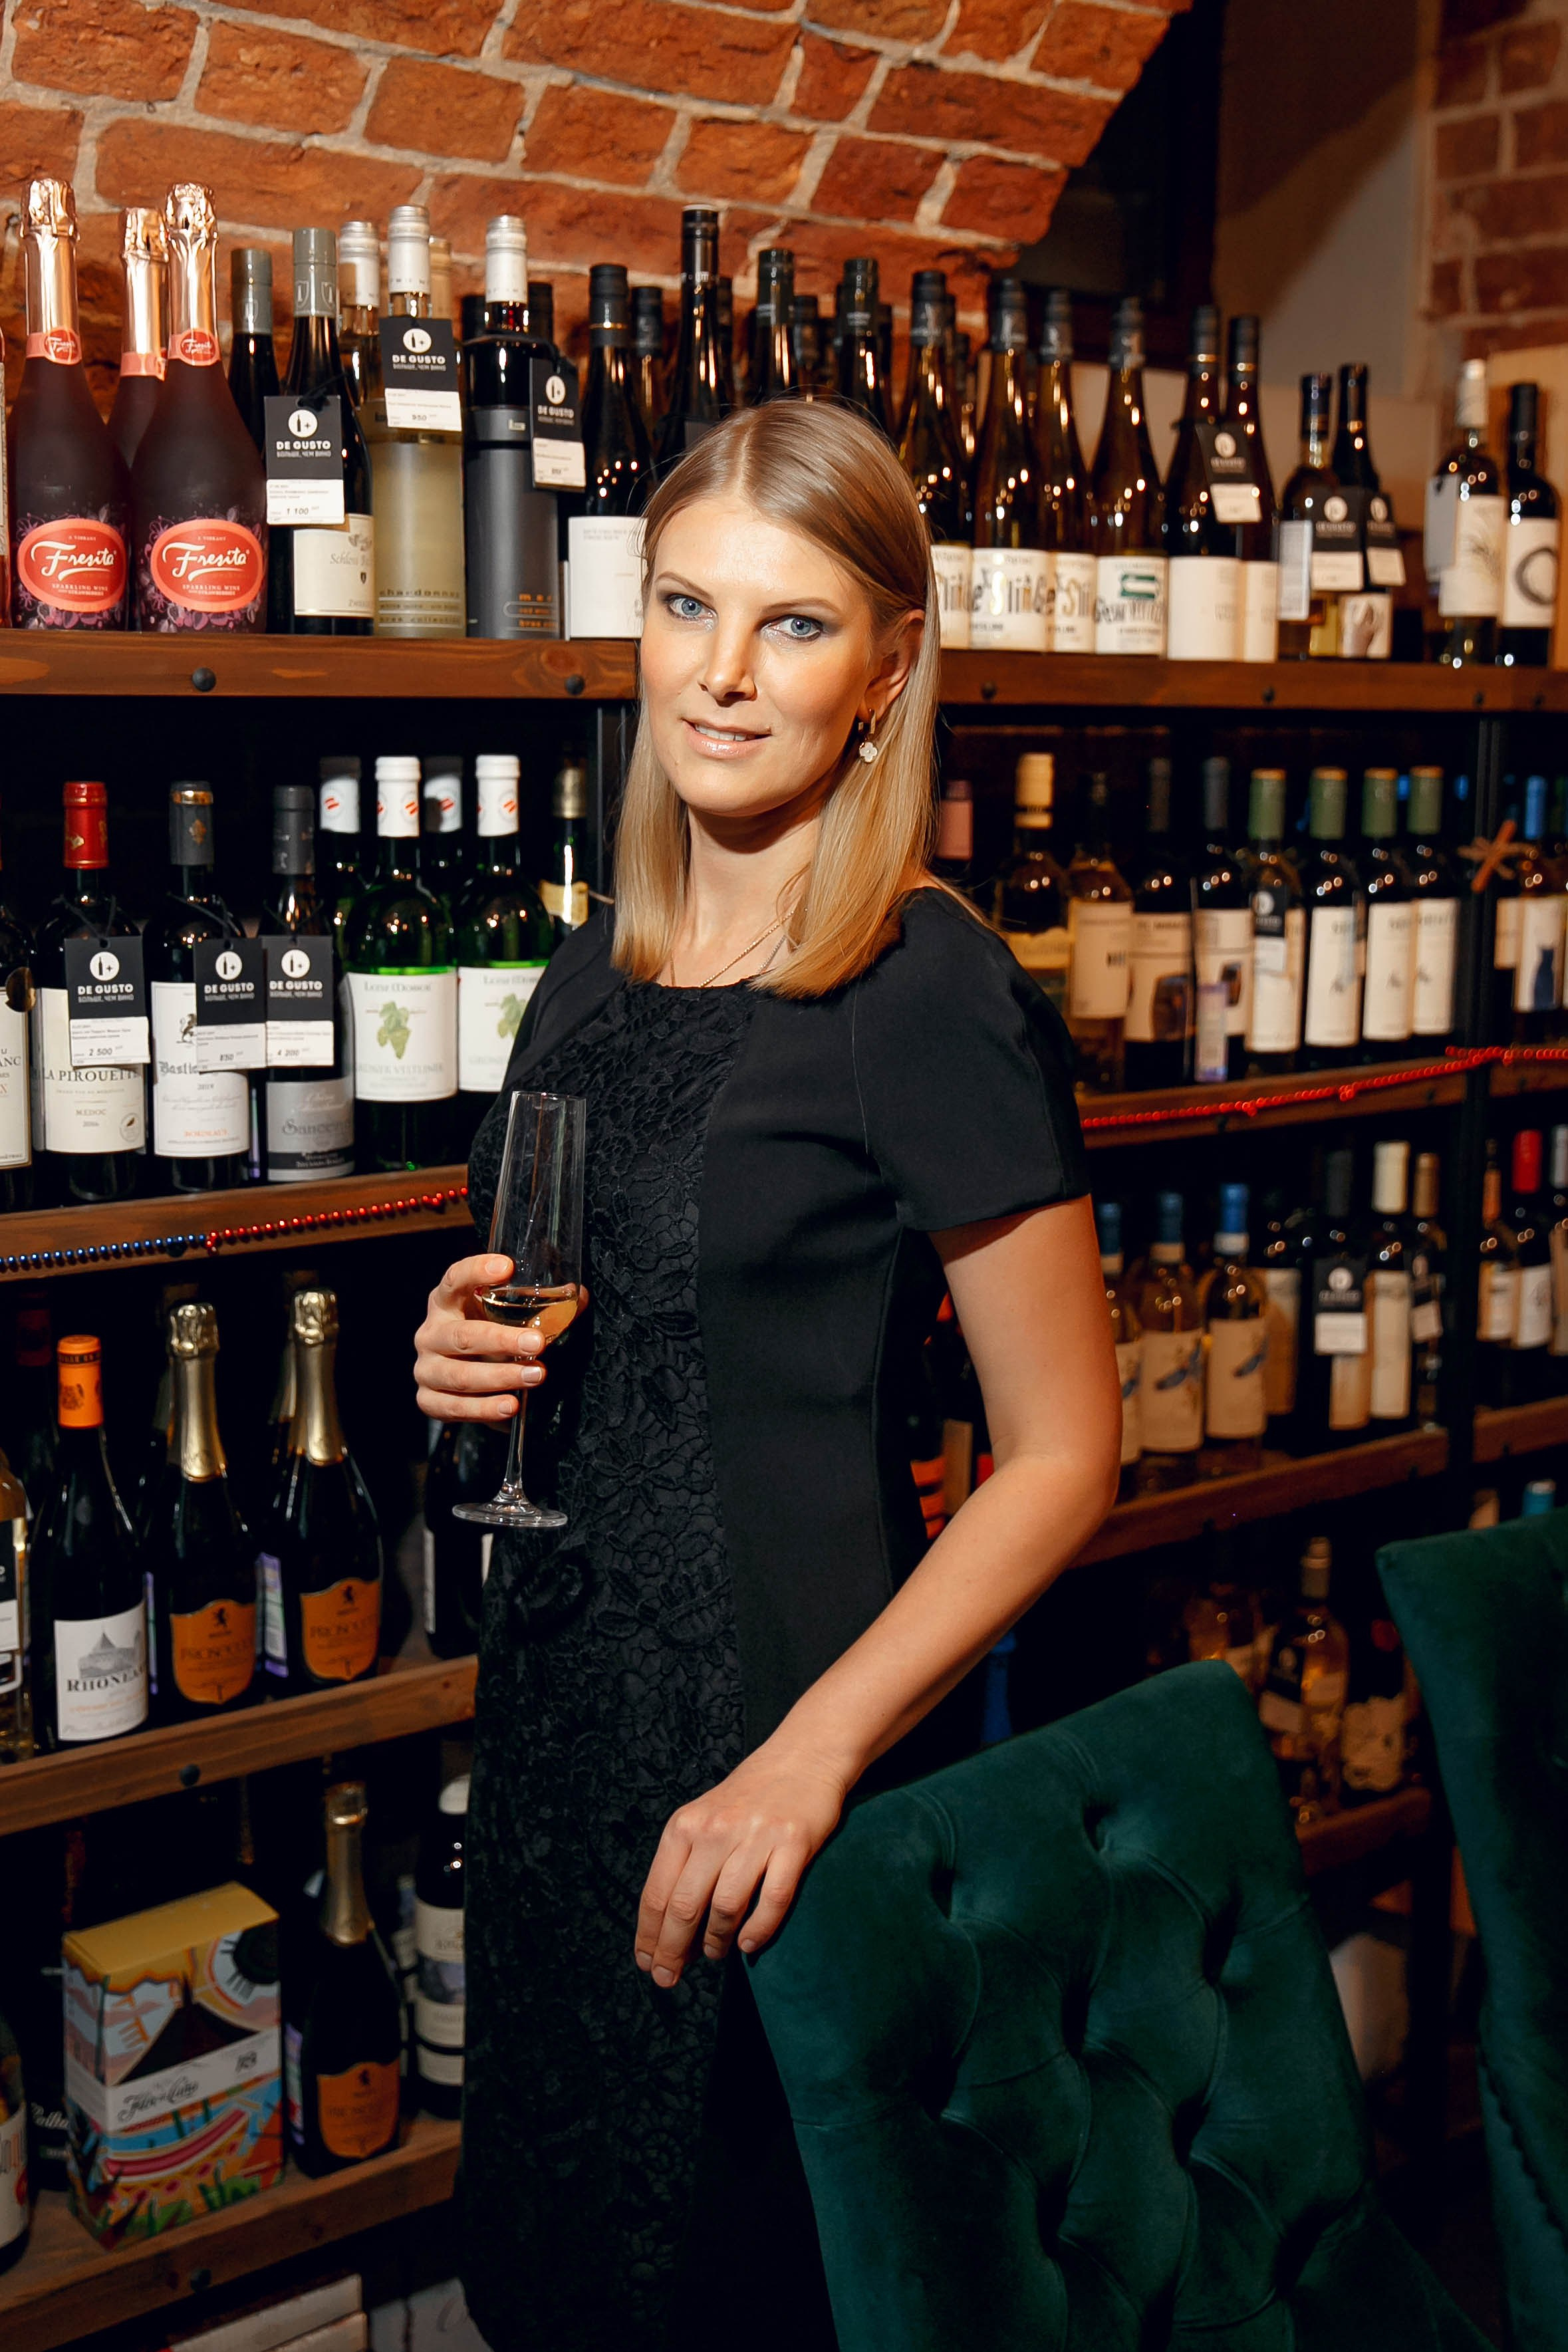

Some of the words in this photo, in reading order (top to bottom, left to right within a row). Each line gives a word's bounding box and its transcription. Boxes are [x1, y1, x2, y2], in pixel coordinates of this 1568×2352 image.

[392, 354, 406, 363] DE
[408, 355, 446, 364] GUSTO
[537, 405, 547, 415] DE
[549, 406, 575, 419] GUSTO
[277, 442, 291, 450] DE
[293, 441, 331, 450] GUSTO
[31, 541, 115, 577] Fresita
[162, 542, 247, 578] Fresita
[78, 986, 92, 995] DE
[95, 983, 133, 993] GUSTO
[204, 985, 217, 993] DE
[220, 982, 254, 992] GUSTO
[269, 981, 283, 989] DE
[286, 980, 323, 990] GUSTO
